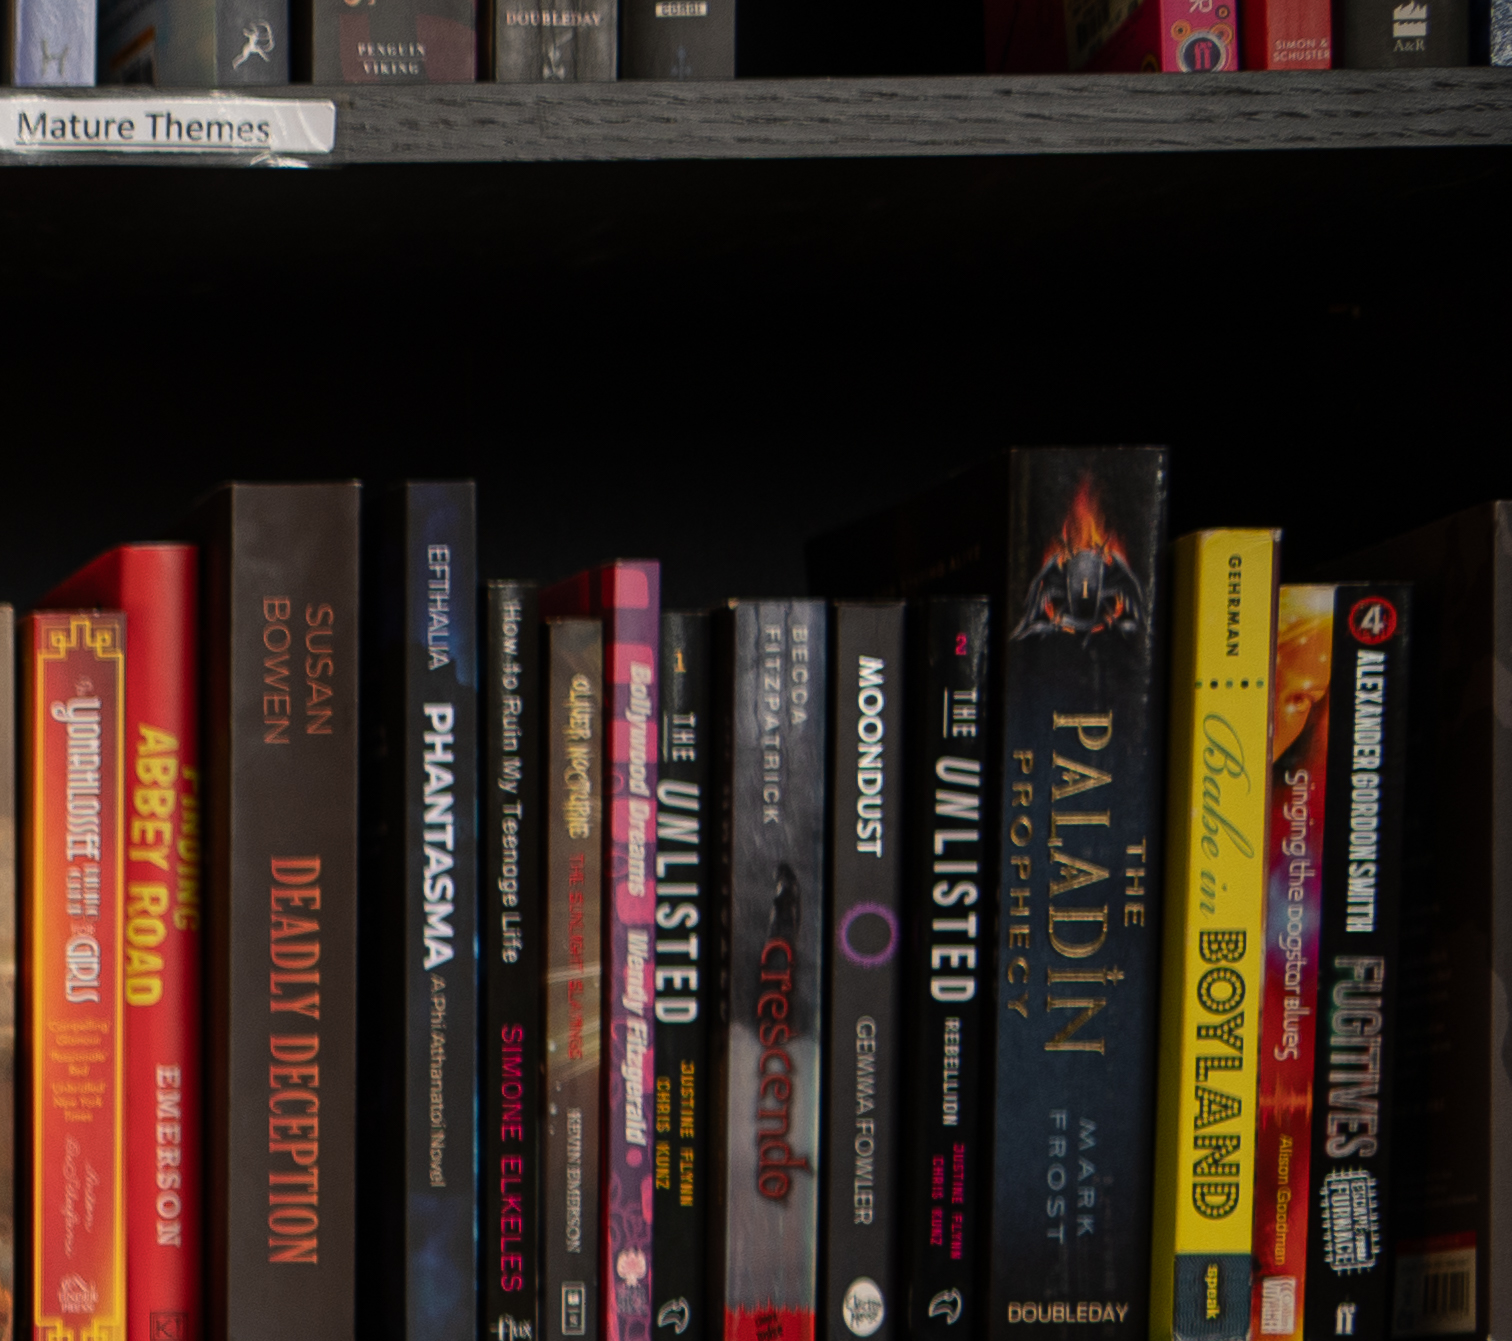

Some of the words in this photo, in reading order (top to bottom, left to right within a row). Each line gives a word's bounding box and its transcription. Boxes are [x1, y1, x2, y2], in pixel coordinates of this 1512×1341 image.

[17, 111, 135, 142] Mature
[145, 112, 271, 144] Themes
[263, 597, 291, 745] BOWEN
[306, 604, 332, 736] SUSAN
[1225, 555, 1243, 658] GEHRMAN
[130, 725, 178, 869] ABBEY
[857, 656, 883, 857] MOONDUST
[424, 702, 454, 970] PHANTASMA
[930, 758, 981, 1003] UNLISTED
[1045, 710, 1114, 1055] PALADIN
[126, 881, 165, 1007] ROAD
[271, 856, 321, 1016] DEADLY
[759, 940, 808, 1200] crescendo
[1192, 930, 1247, 1220] BOYLAND
[269, 1033, 321, 1264] DECEPTION
[1007, 1302, 1128, 1326] DOUBLEDAY
[1204, 1263, 1221, 1320] speak
